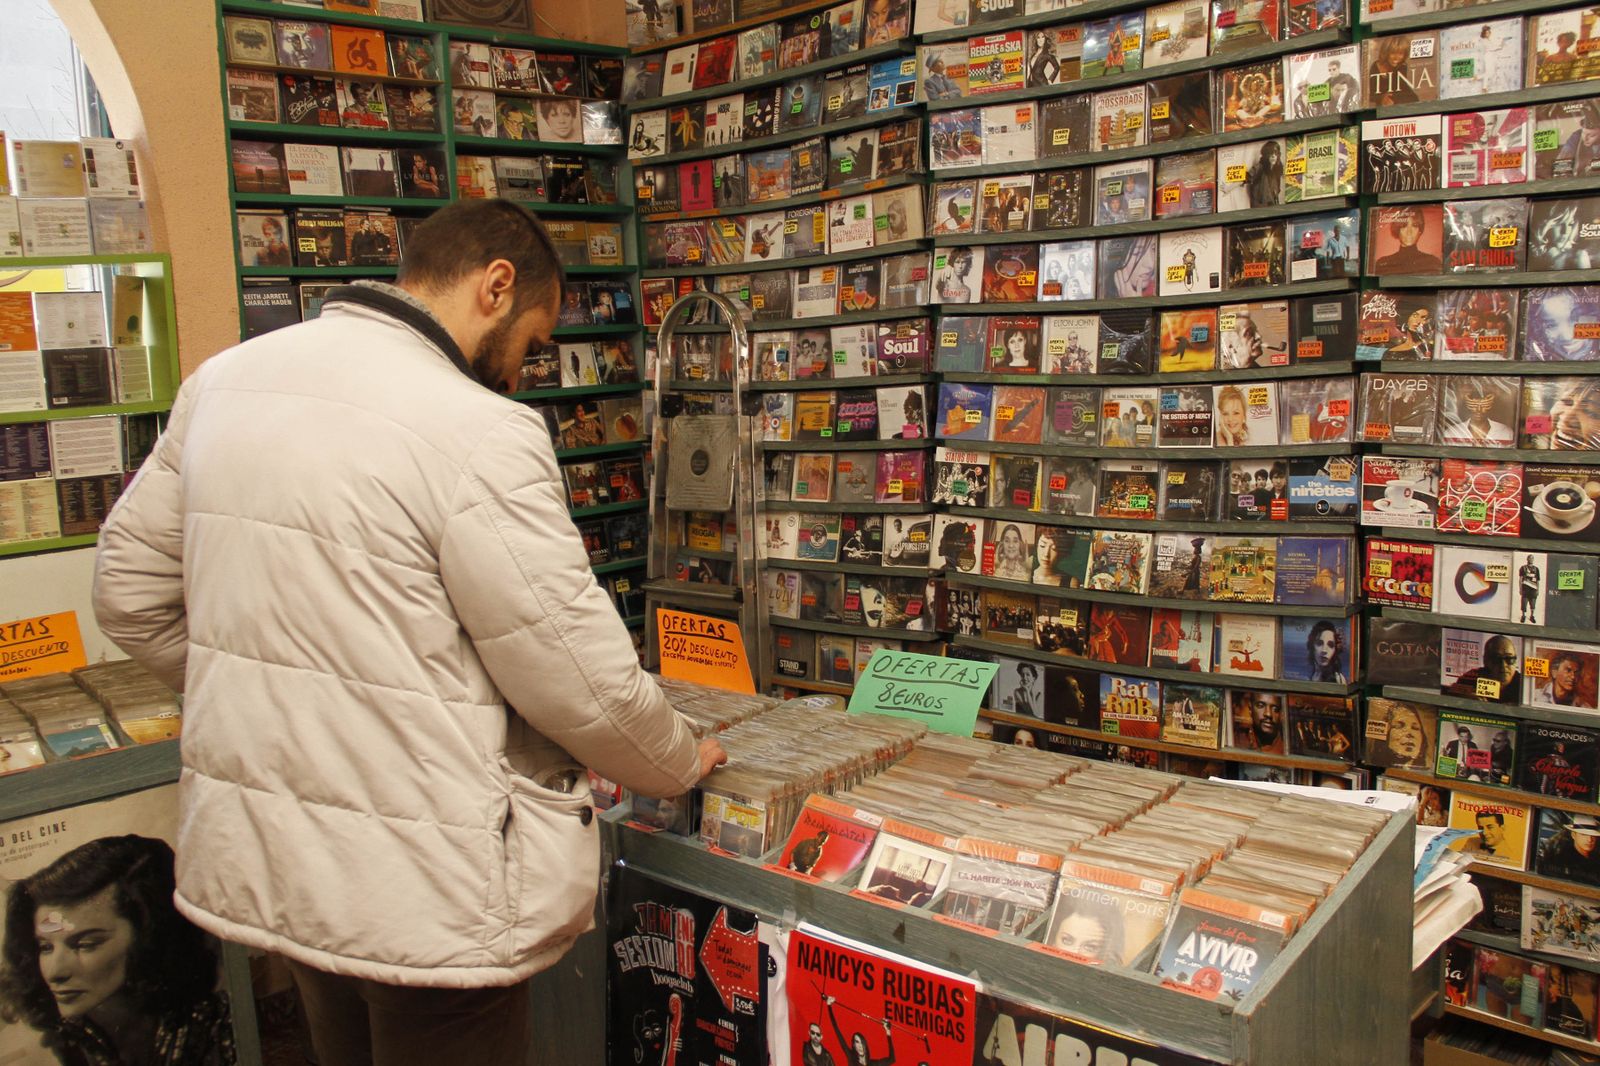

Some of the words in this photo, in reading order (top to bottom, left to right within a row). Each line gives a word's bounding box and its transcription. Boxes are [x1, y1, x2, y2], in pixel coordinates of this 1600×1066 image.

[970, 44, 1000, 58] REGGAE
[1004, 42, 1022, 52] SKA
[1370, 68, 1435, 94] TINA
[1383, 122, 1416, 137] MOTOWN
[1309, 145, 1333, 159] BRASIL
[788, 207, 822, 218] FOREIGNER
[1451, 251, 1476, 266] SAM
[1053, 319, 1074, 327] ELTON
[1074, 319, 1095, 327] JOHN
[884, 338, 919, 355] Soul
[1373, 379, 1427, 391] DAY26
[945, 452, 964, 462] STATUS
[1291, 486, 1355, 497] nineties
[1370, 542, 1380, 550] Will
[1381, 543, 1389, 551] You
[1390, 543, 1400, 551] Love
[1409, 545, 1433, 555] Tomorrow
[663, 614, 725, 640] OFERTAS
[3, 641, 69, 664] DESCUENTO
[664, 635, 686, 655] 20%
[690, 642, 738, 664] DESCUENTO
[1376, 641, 1439, 656] GOTAN
[1446, 641, 1480, 650] VINICIUS
[662, 650, 685, 660] EXCEPTO
[872, 654, 990, 684] OFERTAS
[1111, 677, 1149, 698] Raï
[1107, 694, 1154, 716] RnB
[1549, 730, 1588, 742] GRANDES
[1457, 801, 1479, 813] TITO
[12, 830, 33, 844] DEL
[40, 821, 67, 837] CINE
[1061, 885, 1120, 907] carmen
[1177, 931, 1195, 959] A
[1199, 934, 1258, 976] VIVIR
[651, 969, 694, 993] boogaclub
[797, 941, 874, 991] NANCYS
[883, 967, 965, 1019] RUBIAS
[884, 1004, 966, 1043] ENEMIGAS
